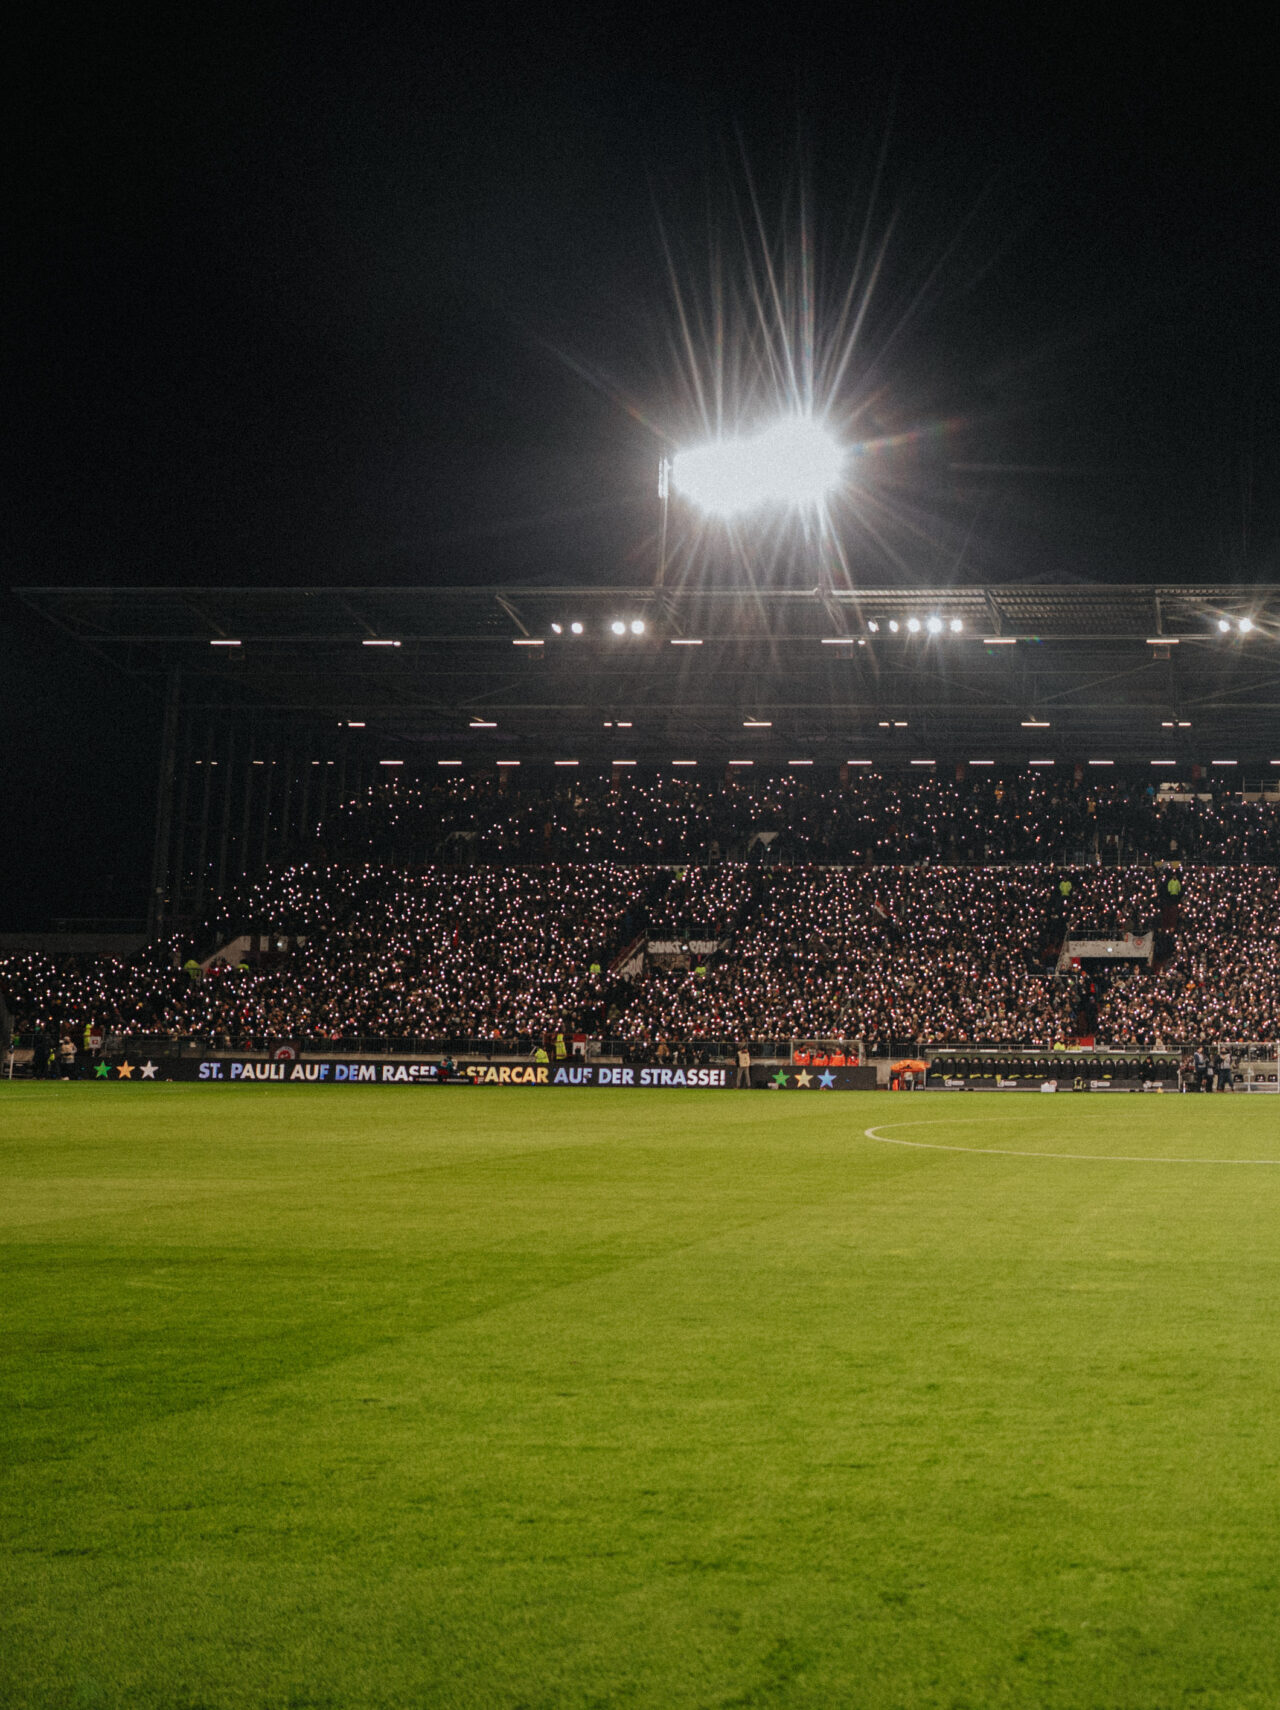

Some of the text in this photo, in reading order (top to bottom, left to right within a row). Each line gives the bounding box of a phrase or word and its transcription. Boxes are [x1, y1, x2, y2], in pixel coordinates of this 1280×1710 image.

[198, 1062, 223, 1079] ST.
[230, 1063, 285, 1080] PAULI
[290, 1064, 329, 1081] AUF
[335, 1064, 376, 1081] DEM
[466, 1066, 549, 1083] STARCAR
[553, 1067, 592, 1084] AUF
[598, 1068, 634, 1084] DER
[640, 1069, 726, 1086] STRASSE!
